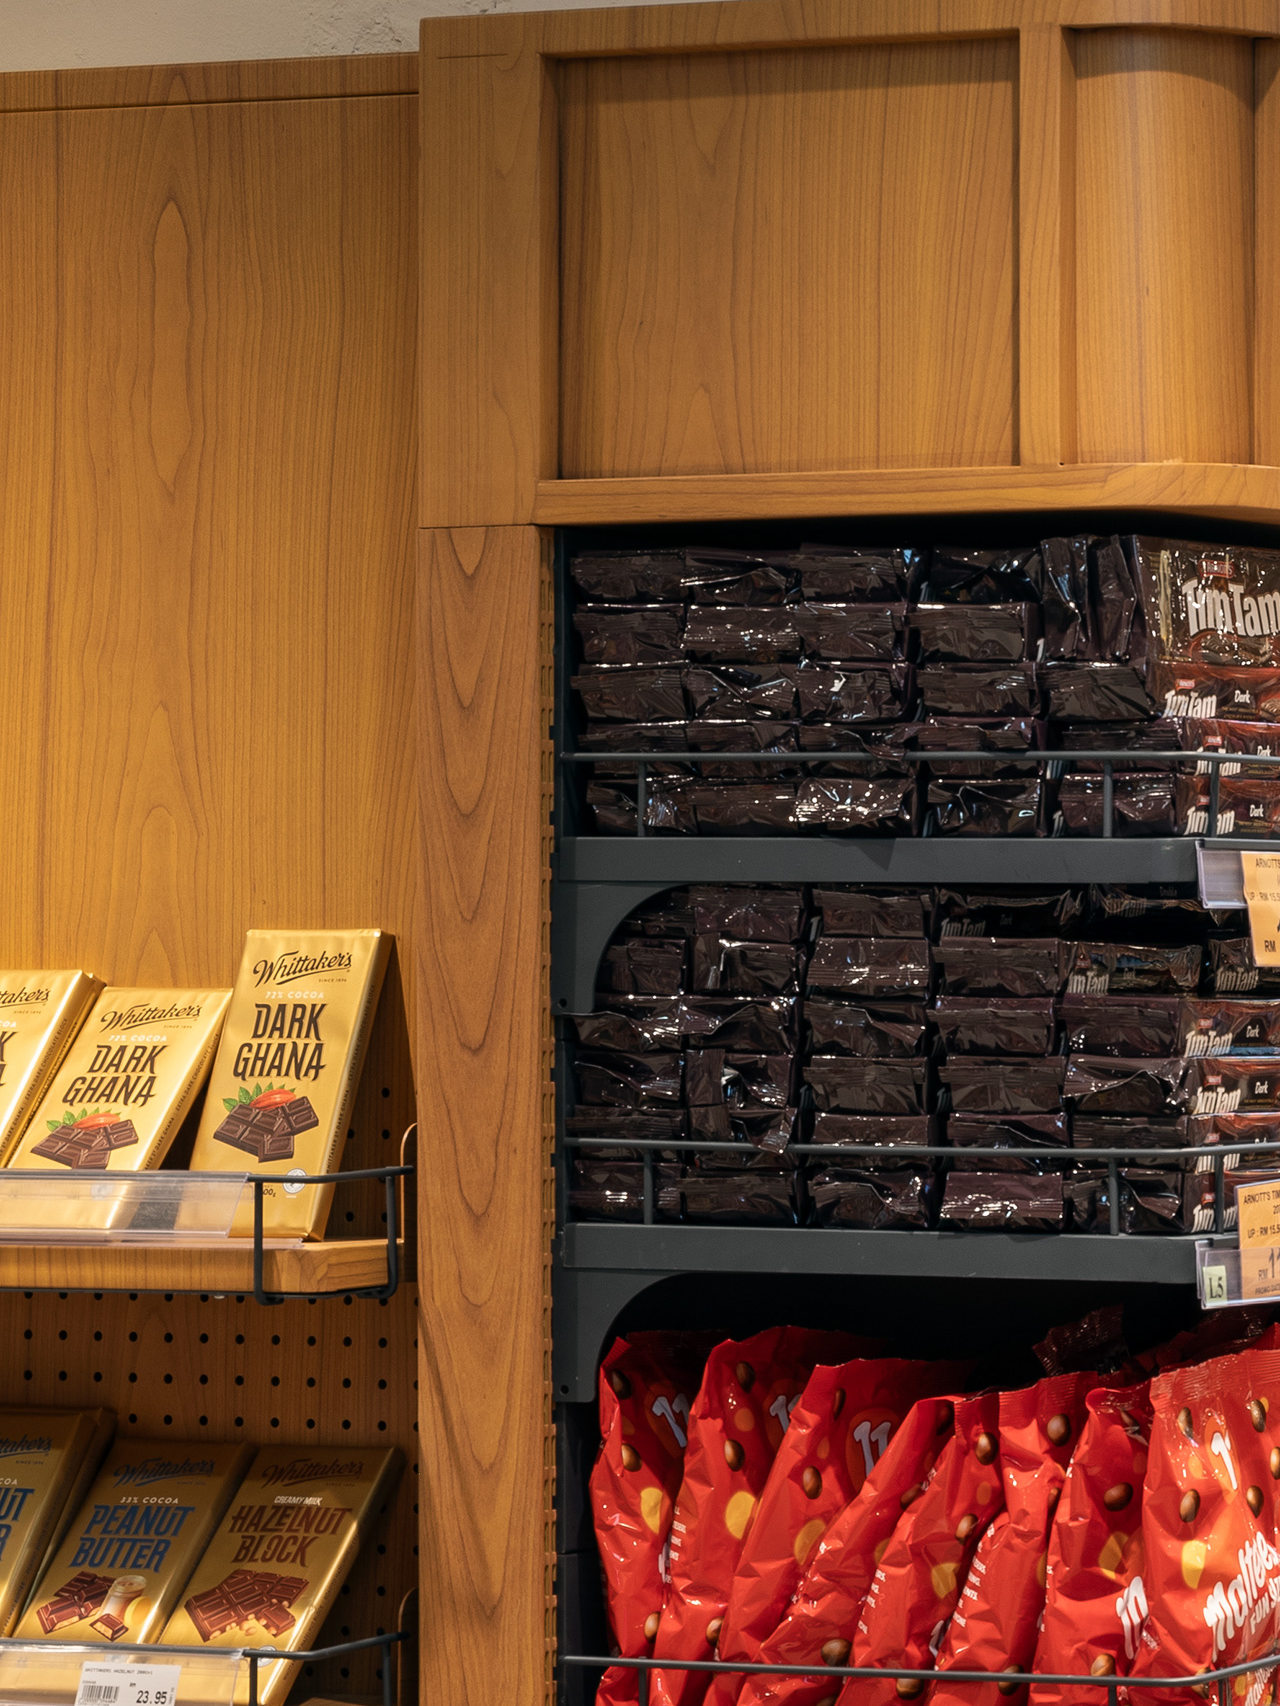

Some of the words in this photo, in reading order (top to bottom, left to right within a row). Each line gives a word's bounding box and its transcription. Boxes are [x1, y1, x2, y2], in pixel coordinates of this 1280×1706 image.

[1234, 689, 1250, 704] Dark
[1256, 859, 1280, 869] ARNOTTS
[1264, 940, 1276, 952] RM
[254, 949, 352, 988] Whittaker's
[265, 991, 283, 999] 72%
[287, 991, 324, 999] COCOA
[251, 1003, 330, 1041] DARK
[233, 1040, 325, 1081] GHANA
[1258, 1268, 1268, 1281] RM
[1209, 1277, 1224, 1299] L5
[120, 1496, 140, 1504] 33%
[142, 1496, 179, 1505] COCOA
[274, 1495, 303, 1505] CREAMY
[303, 1496, 324, 1506] MILK
[84, 1505, 196, 1537] PEANUT
[228, 1505, 352, 1536] HAZELNUT
[68, 1536, 173, 1573] BUTTER
[231, 1535, 319, 1567] BLOCK
[136, 1690, 167, 1704] 23.95
